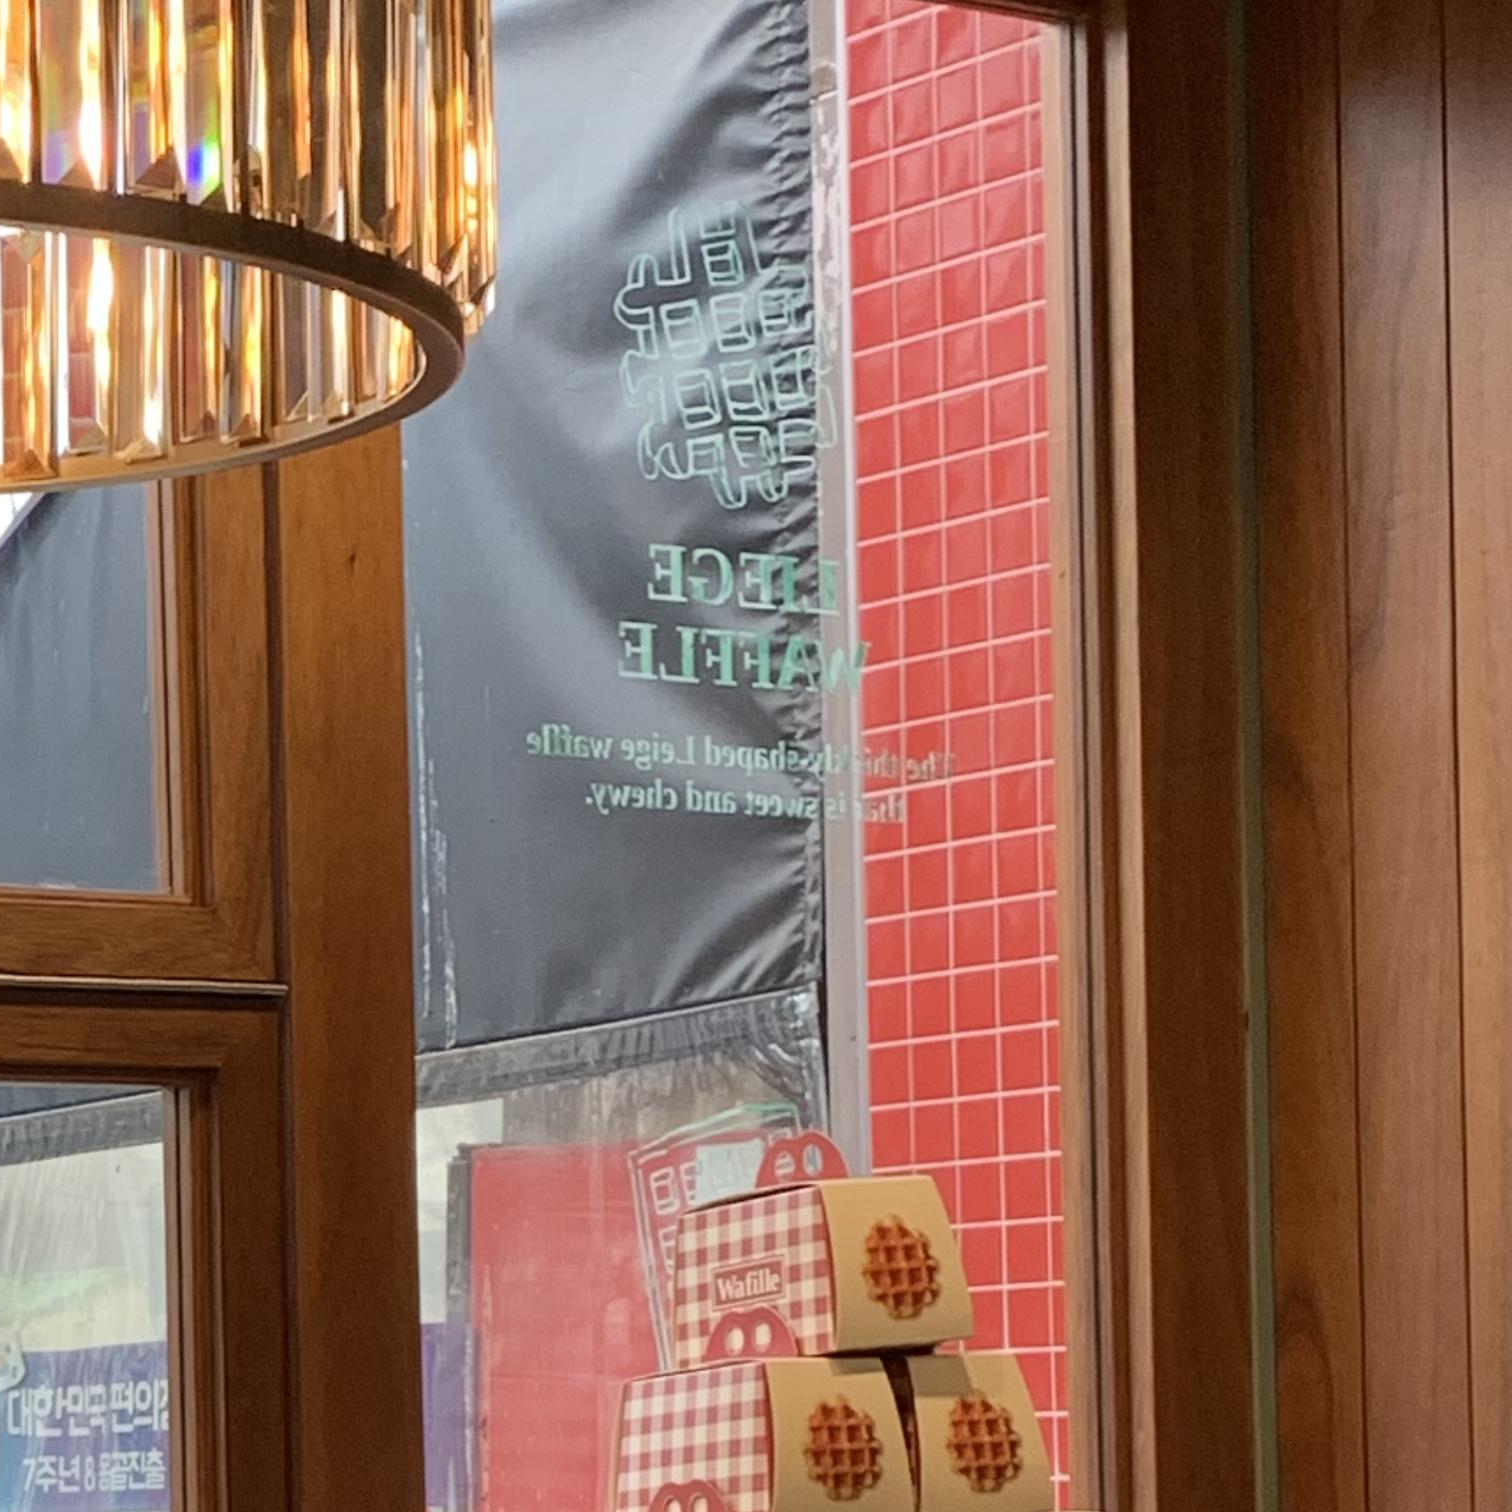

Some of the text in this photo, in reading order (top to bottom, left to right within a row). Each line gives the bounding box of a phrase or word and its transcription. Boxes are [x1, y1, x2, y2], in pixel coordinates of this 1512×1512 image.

[715, 1266, 783, 1302] Wafille
[6, 1383, 108, 1437] 대한민국
[22, 1454, 81, 1493] 7주년
